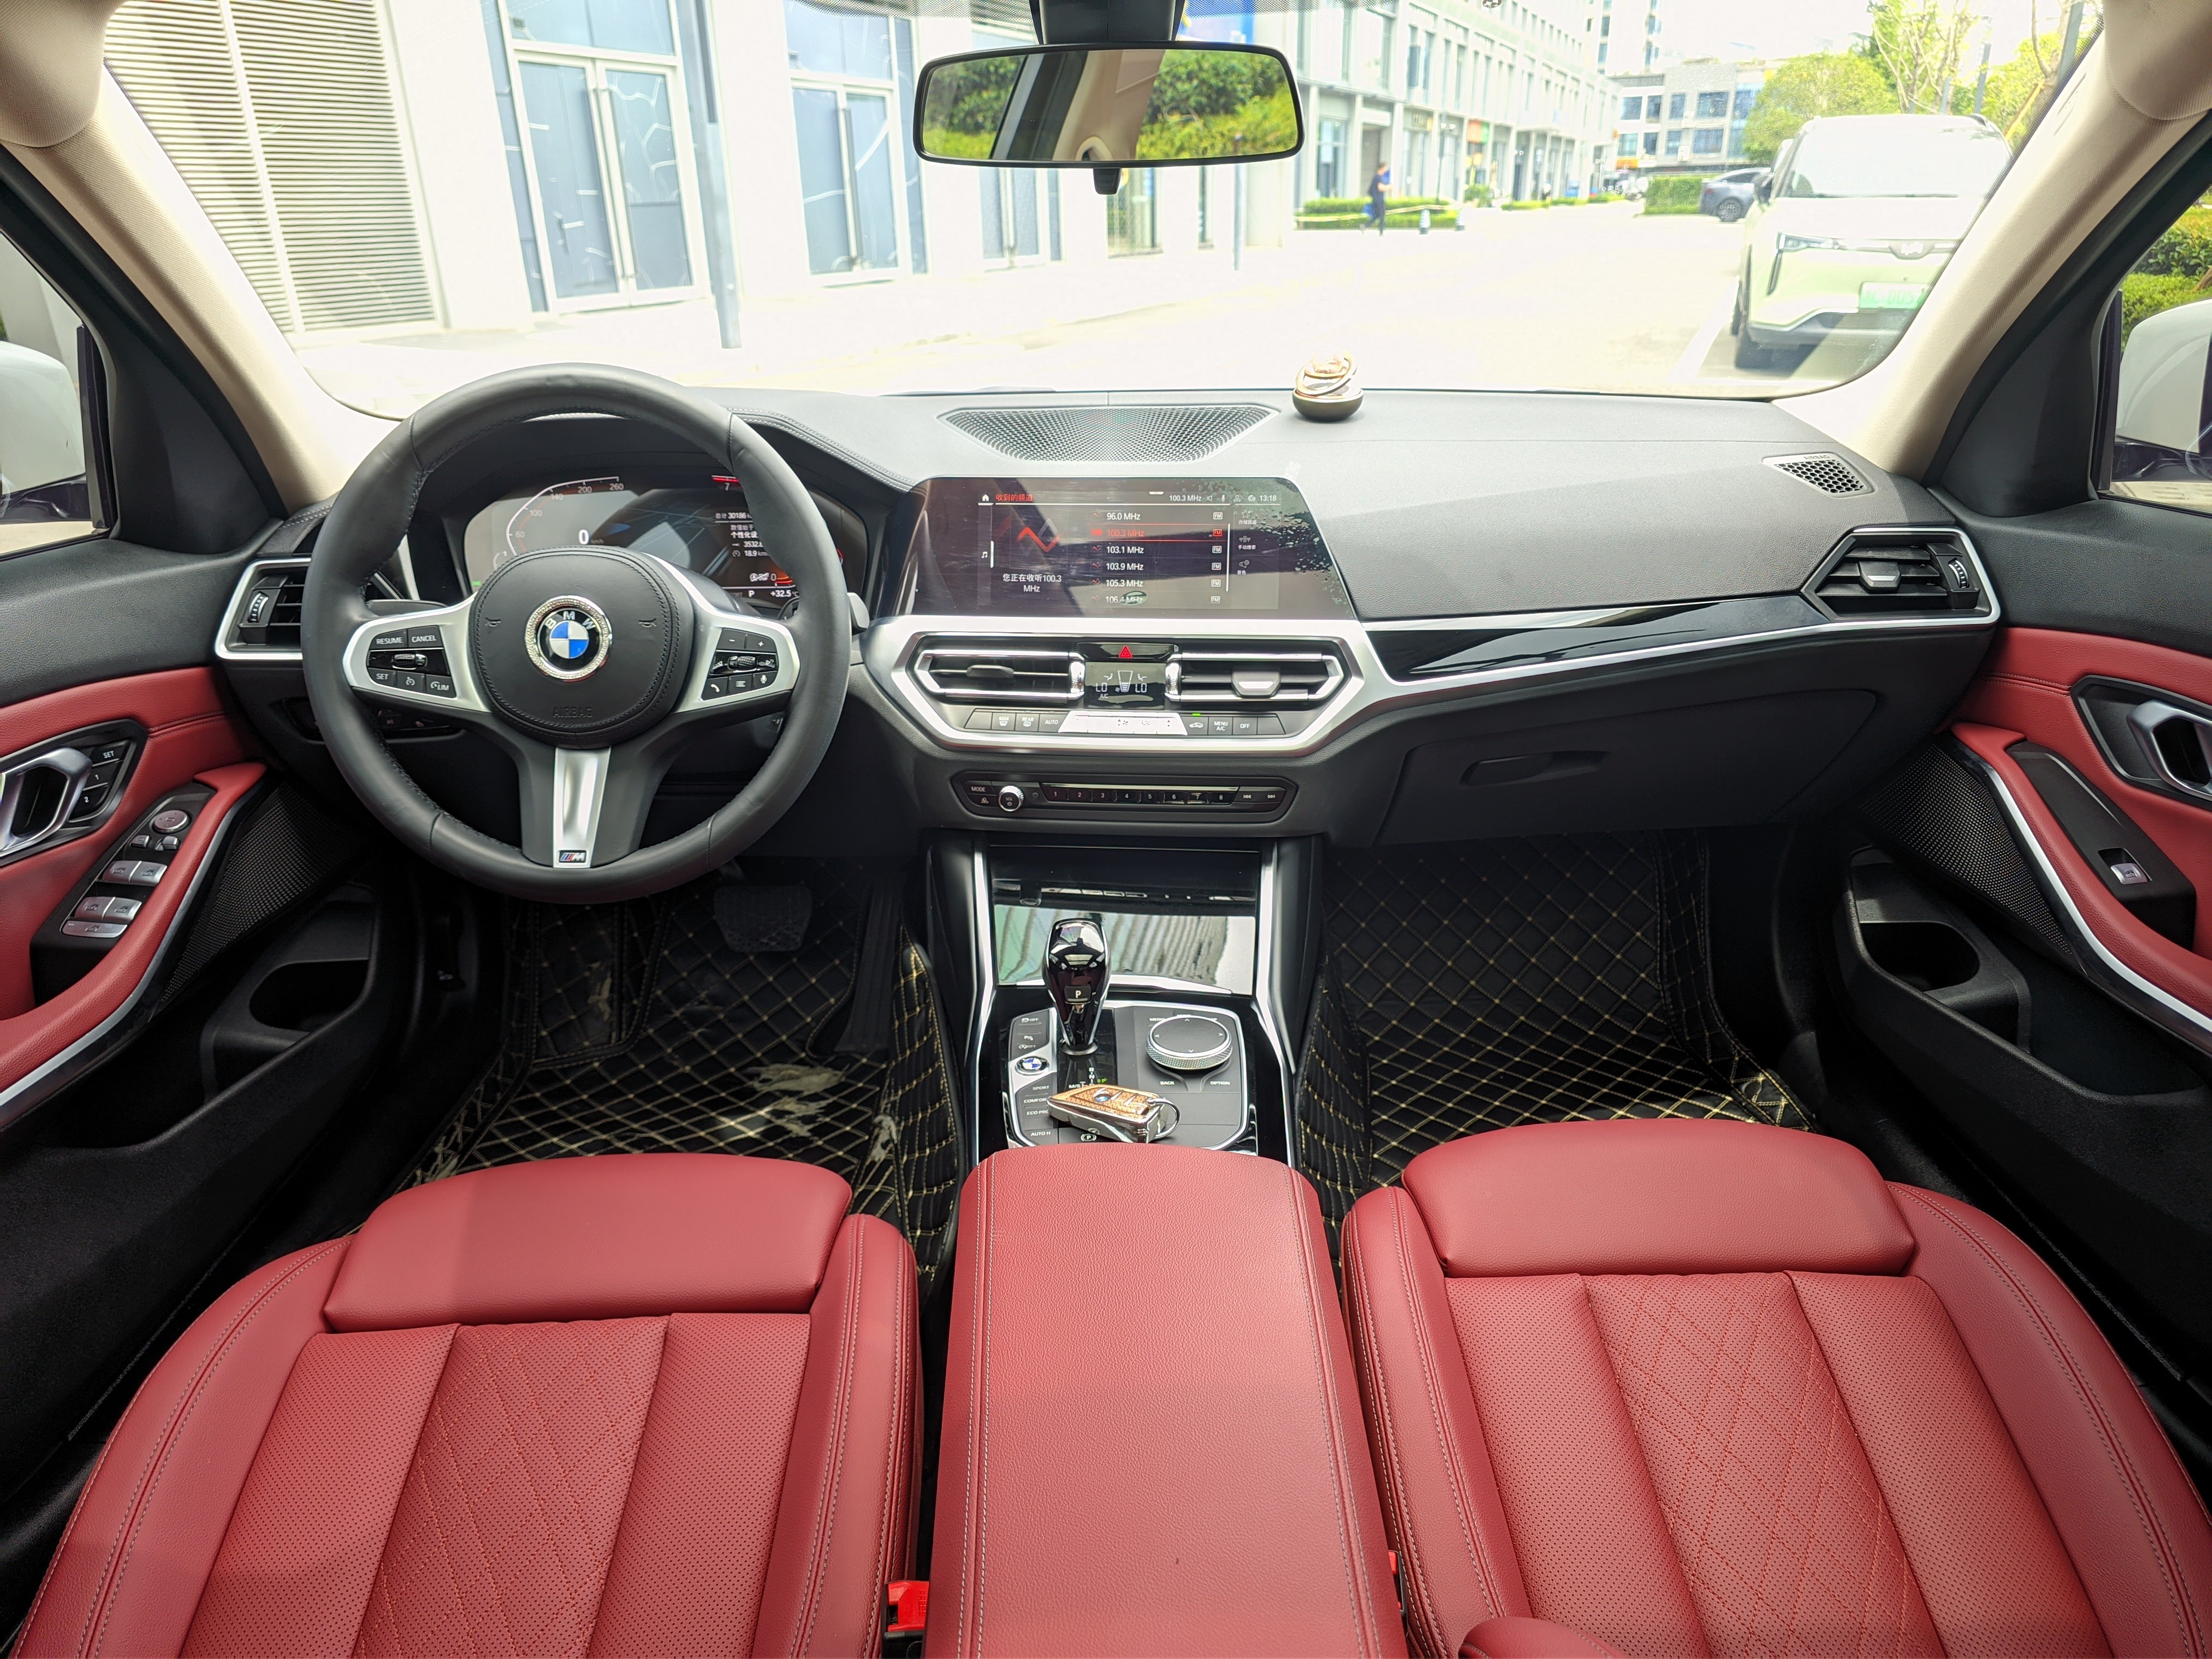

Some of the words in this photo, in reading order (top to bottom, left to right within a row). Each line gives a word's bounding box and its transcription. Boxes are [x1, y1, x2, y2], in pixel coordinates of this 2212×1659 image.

[724, 482, 730, 491] 7
[995, 494, 1033, 502] 收到的频道
[578, 529, 589, 545] 0
[1002, 573, 1062, 583] 您正在收听100.3
[1023, 584, 1041, 593] MHz
[544, 611, 596, 630] BMW
[411, 635, 437, 643] CANCEL
[1095, 682, 1108, 692] LO
[1135, 682, 1147, 693] LO
[103, 750, 115, 759] SET
[1075, 990, 1082, 999] P
